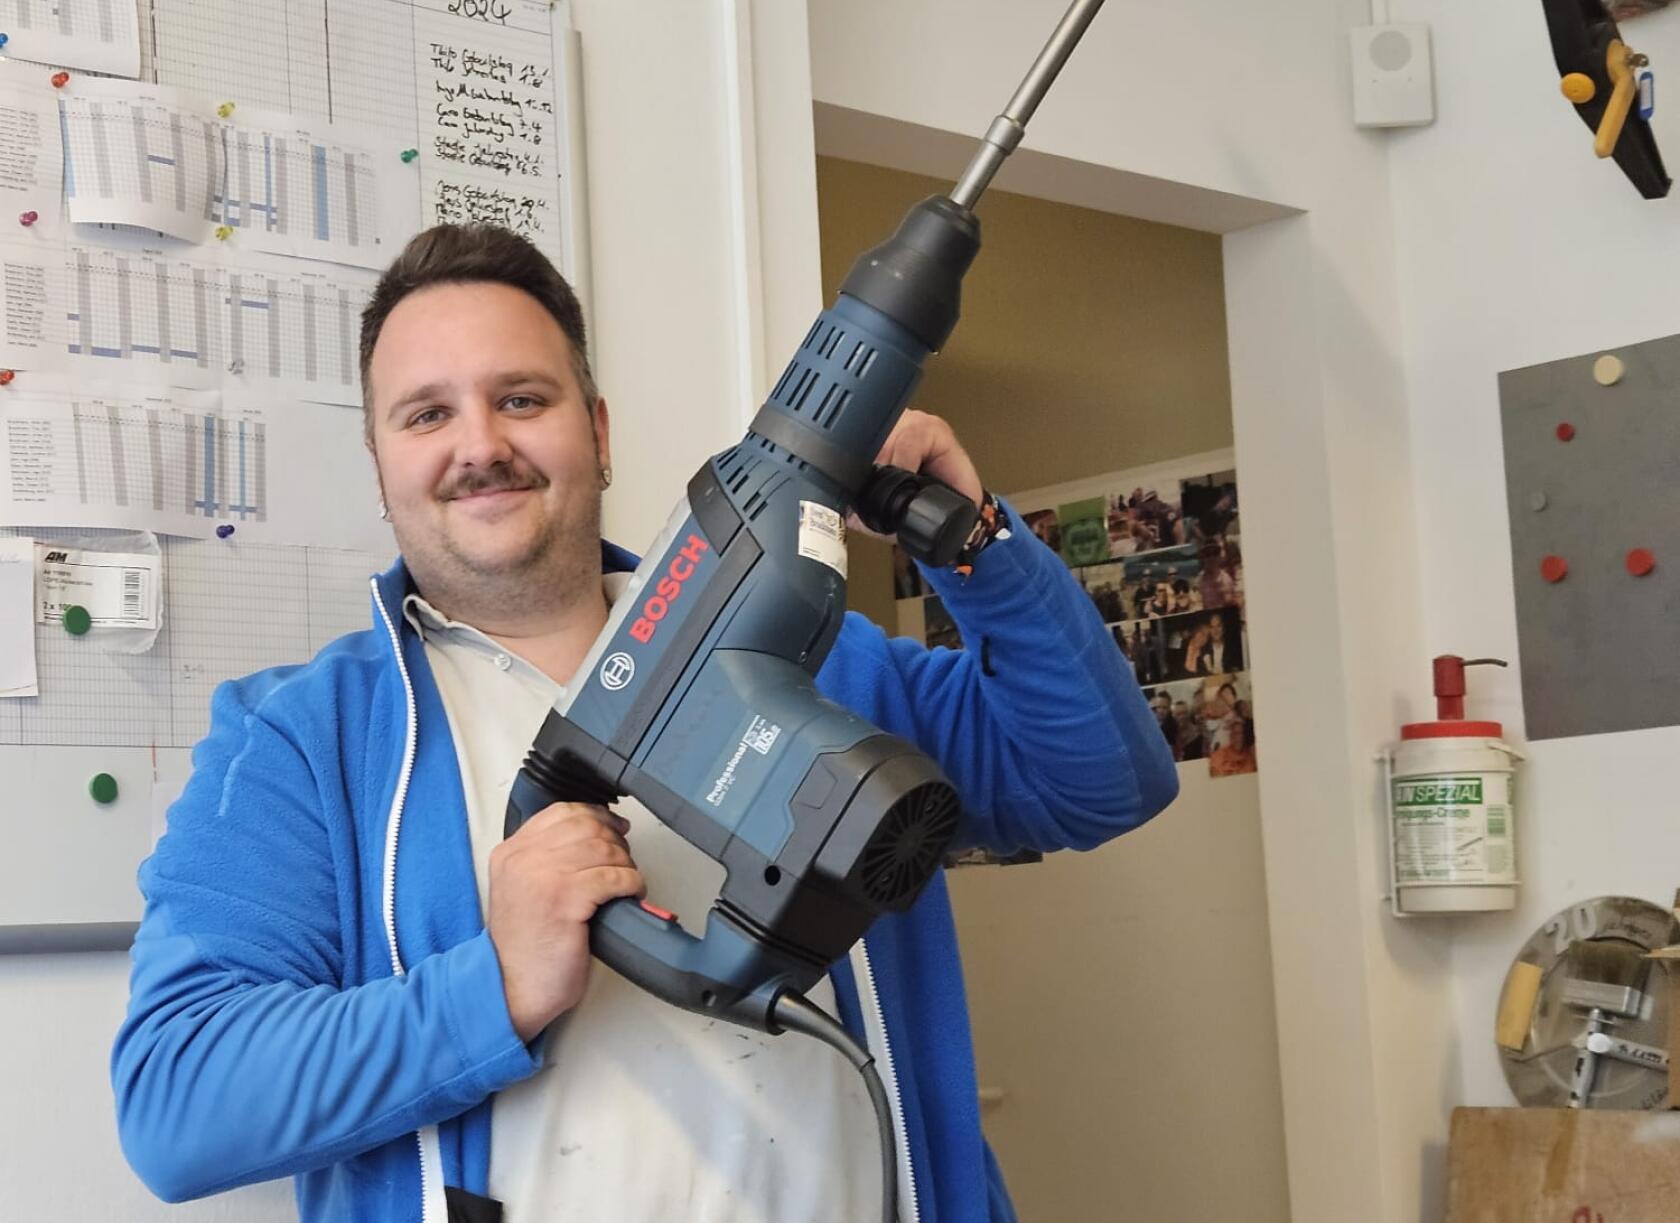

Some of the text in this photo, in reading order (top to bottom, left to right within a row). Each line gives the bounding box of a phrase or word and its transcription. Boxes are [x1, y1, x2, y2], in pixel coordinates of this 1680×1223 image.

[448, 0, 512, 25] 2024
[628, 533, 710, 645] BOSCH
[705, 741, 749, 804] Professional
[1415, 783, 1481, 802] SPEZIAL
